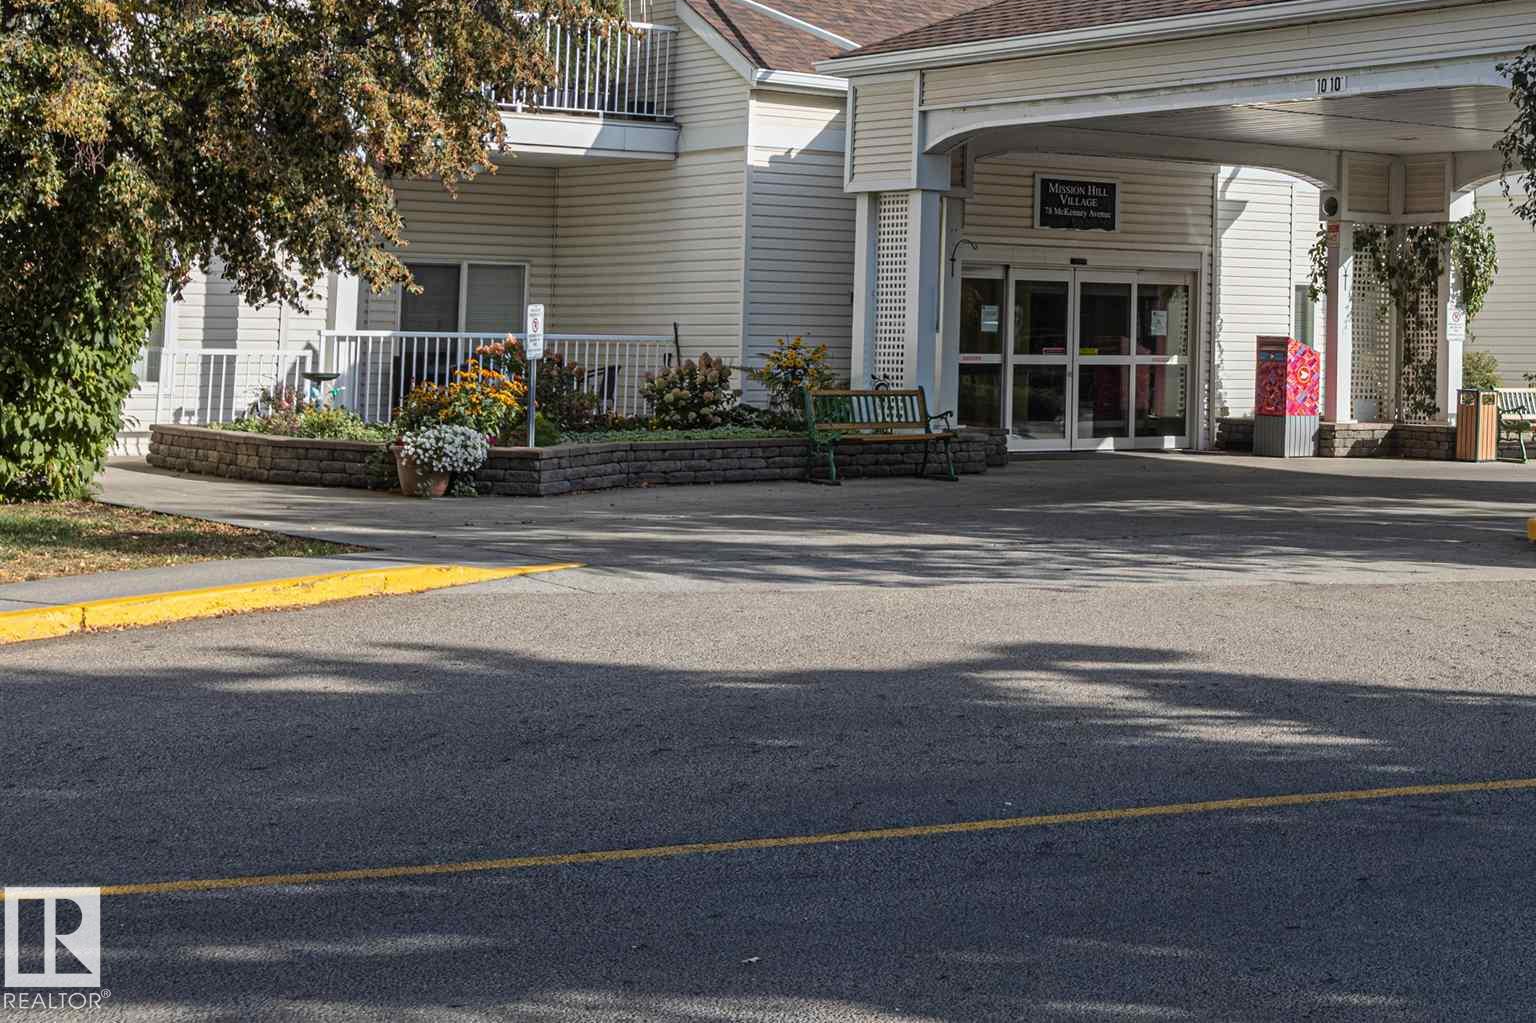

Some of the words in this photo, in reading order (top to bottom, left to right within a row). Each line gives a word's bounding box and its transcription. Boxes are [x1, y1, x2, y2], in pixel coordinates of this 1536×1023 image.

[1048, 182, 1086, 196] MISSION
[1087, 185, 1109, 197] HILL
[1059, 193, 1099, 207] VILLAGE
